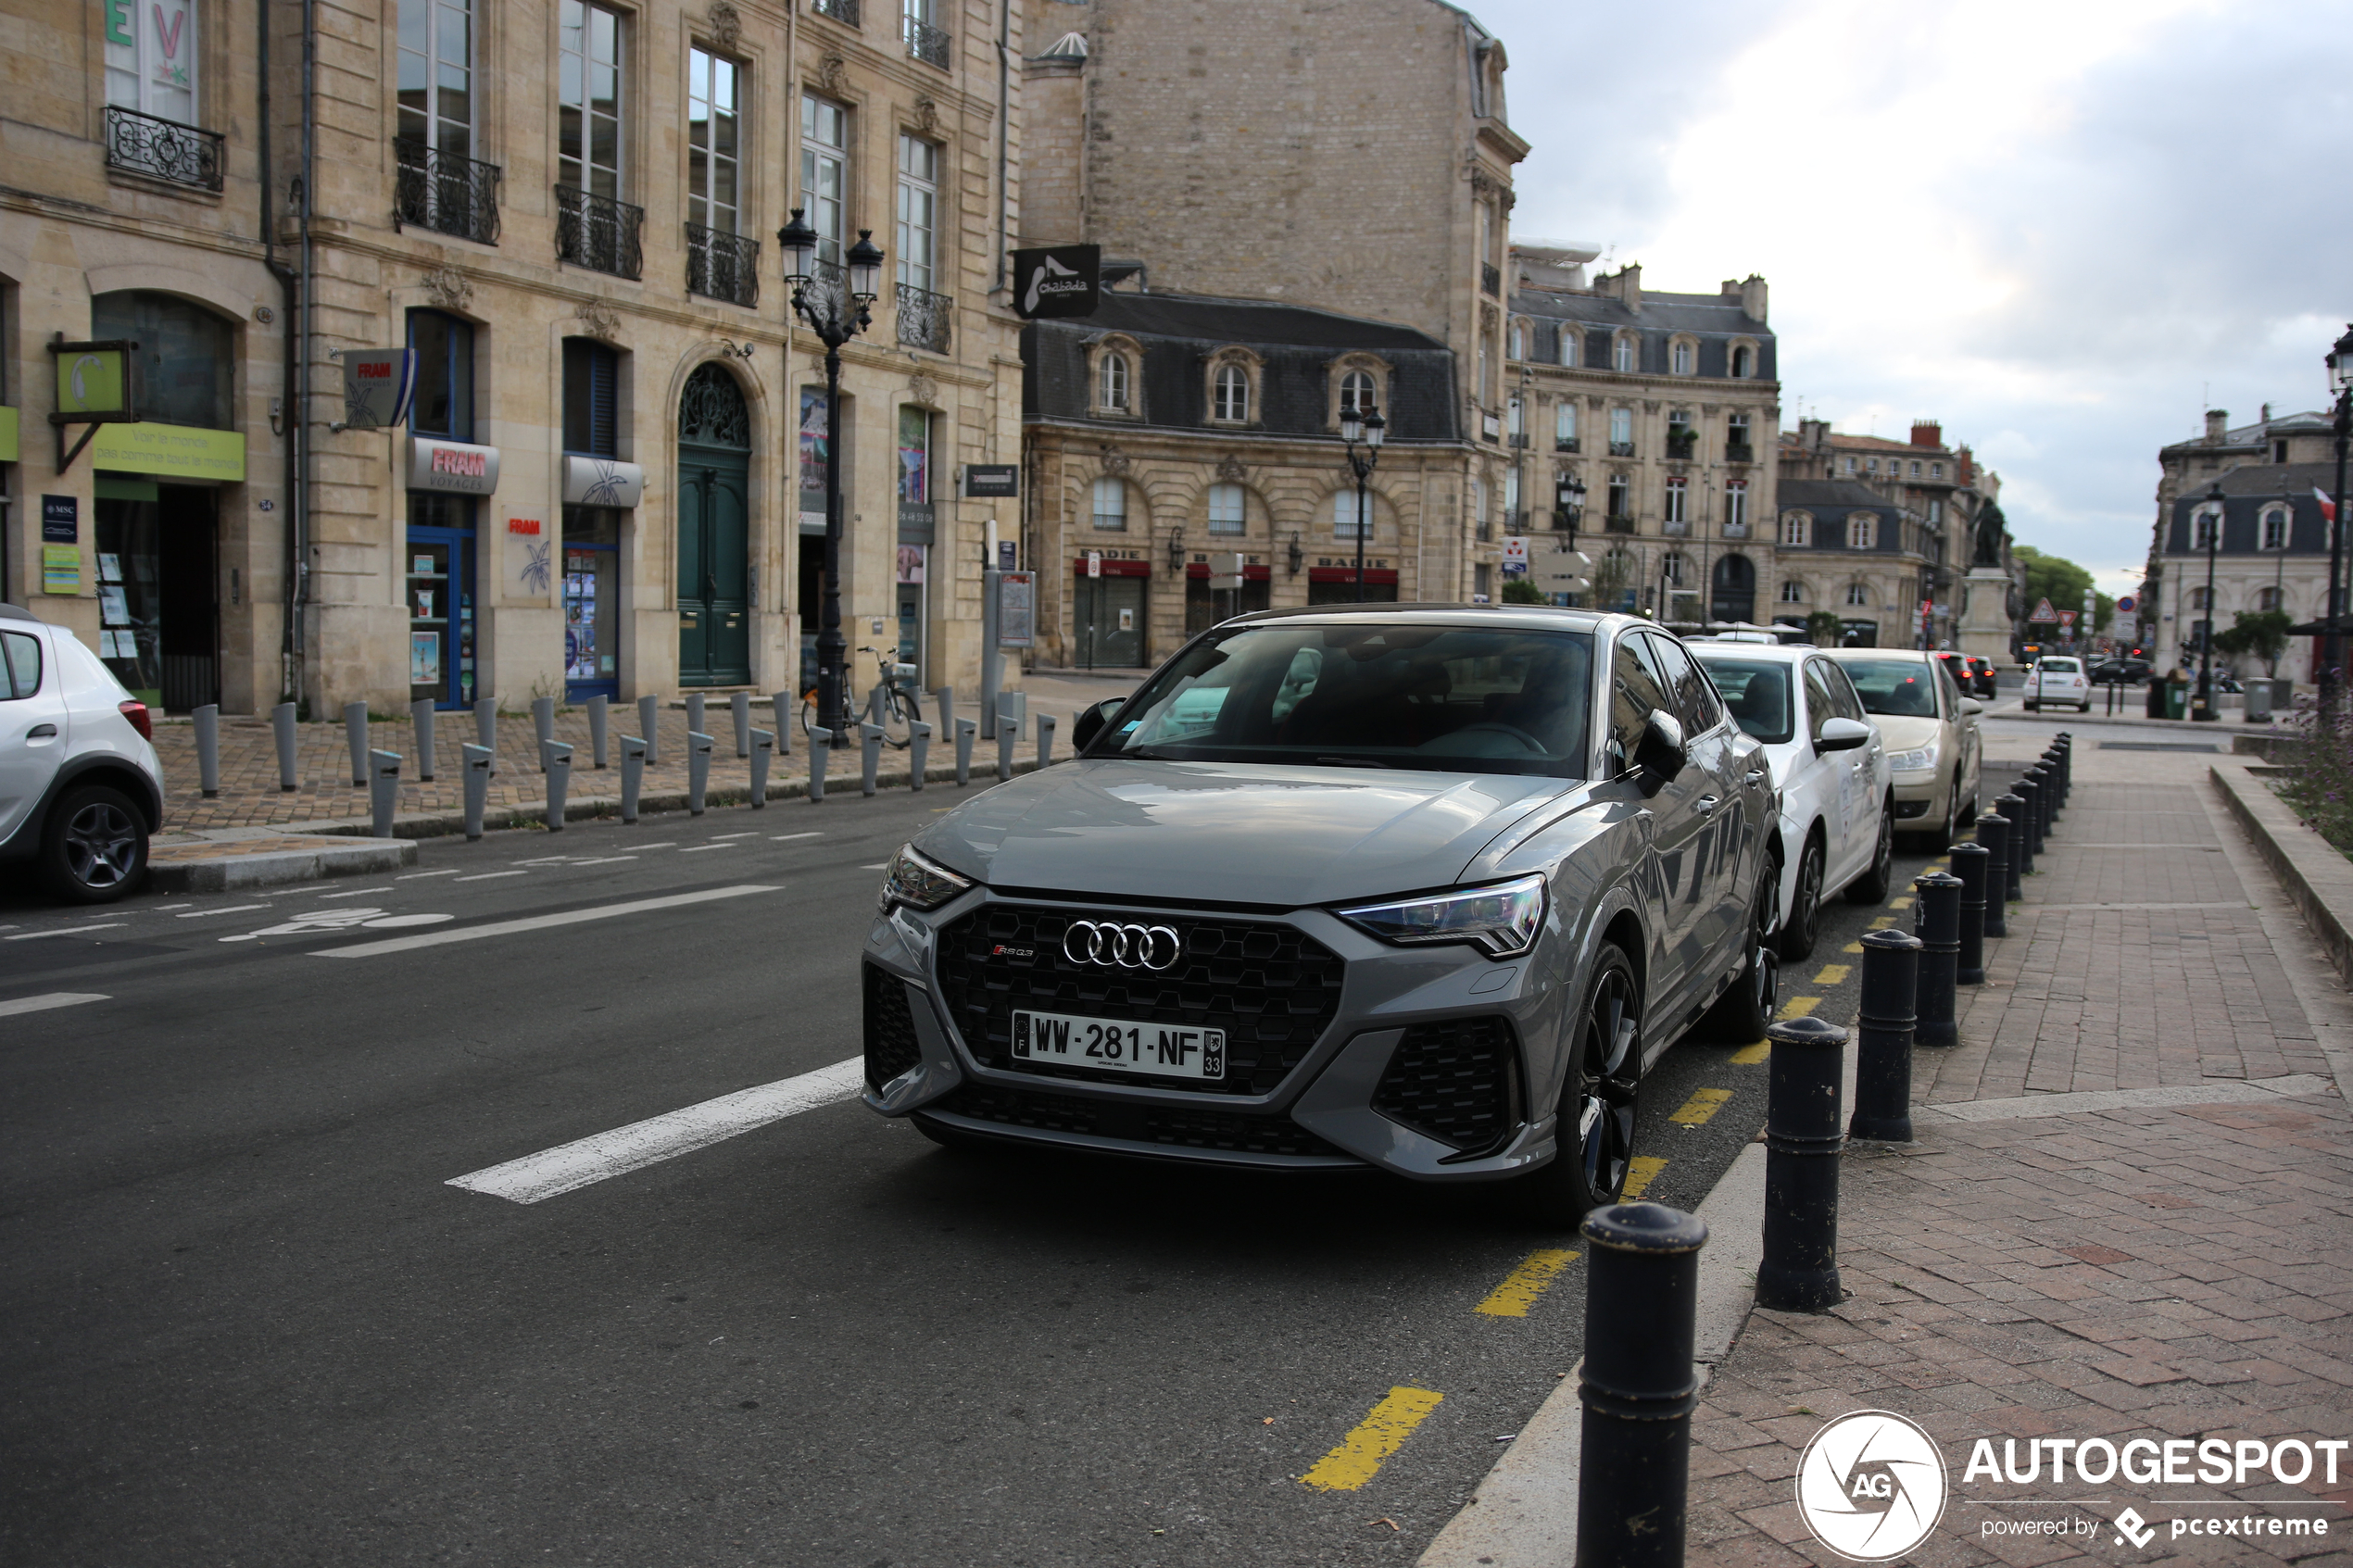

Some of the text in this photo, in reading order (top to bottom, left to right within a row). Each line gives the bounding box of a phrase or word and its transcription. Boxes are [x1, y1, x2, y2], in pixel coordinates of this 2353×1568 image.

[1038, 280, 1088, 293] Chabada
[358, 362, 390, 378] FRAM
[132, 430, 208, 447] Voir le monde
[96, 448, 240, 470] pas comme tout le monde
[433, 448, 485, 476] FRAM
[430, 476, 483, 490] VOYAGES
[55, 506, 74, 514] MSC
[261, 500, 271, 510] 54
[509, 518, 540, 534] FRAM
[1018, 1039, 1025, 1050] F
[1205, 1057, 1221, 1073] 33
